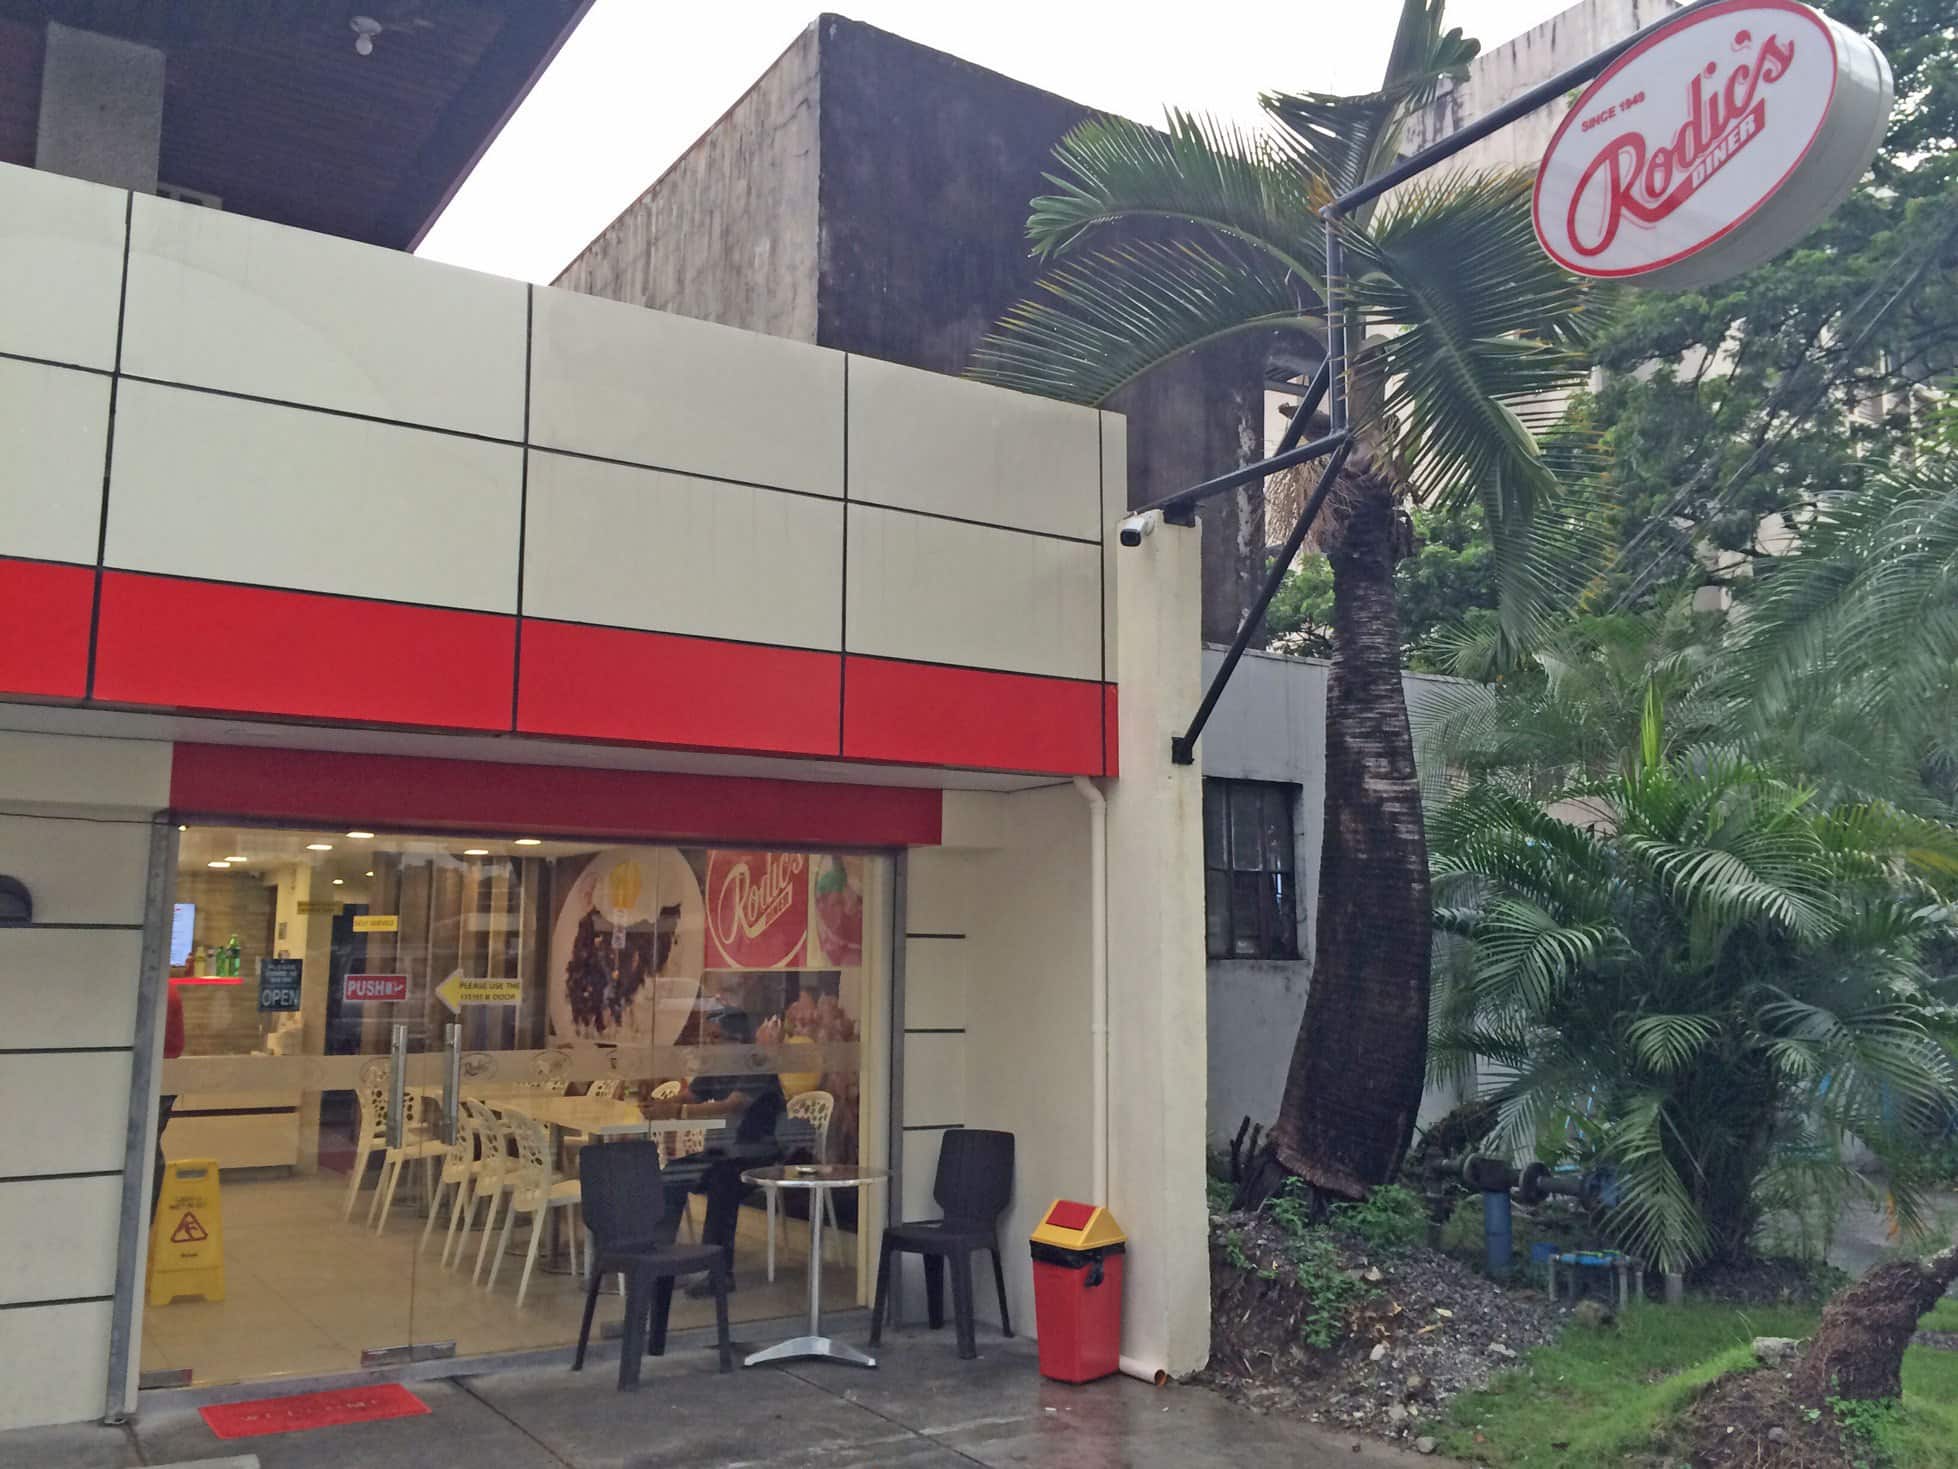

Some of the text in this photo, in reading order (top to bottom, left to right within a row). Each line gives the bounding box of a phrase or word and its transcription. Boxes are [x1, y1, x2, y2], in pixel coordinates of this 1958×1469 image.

[1581, 105, 1616, 132] SINCE
[1566, 29, 1795, 257] Rodic's
[1692, 114, 1756, 190] DINER
[262, 989, 298, 1006] OPEN
[348, 980, 385, 996] PUSH
